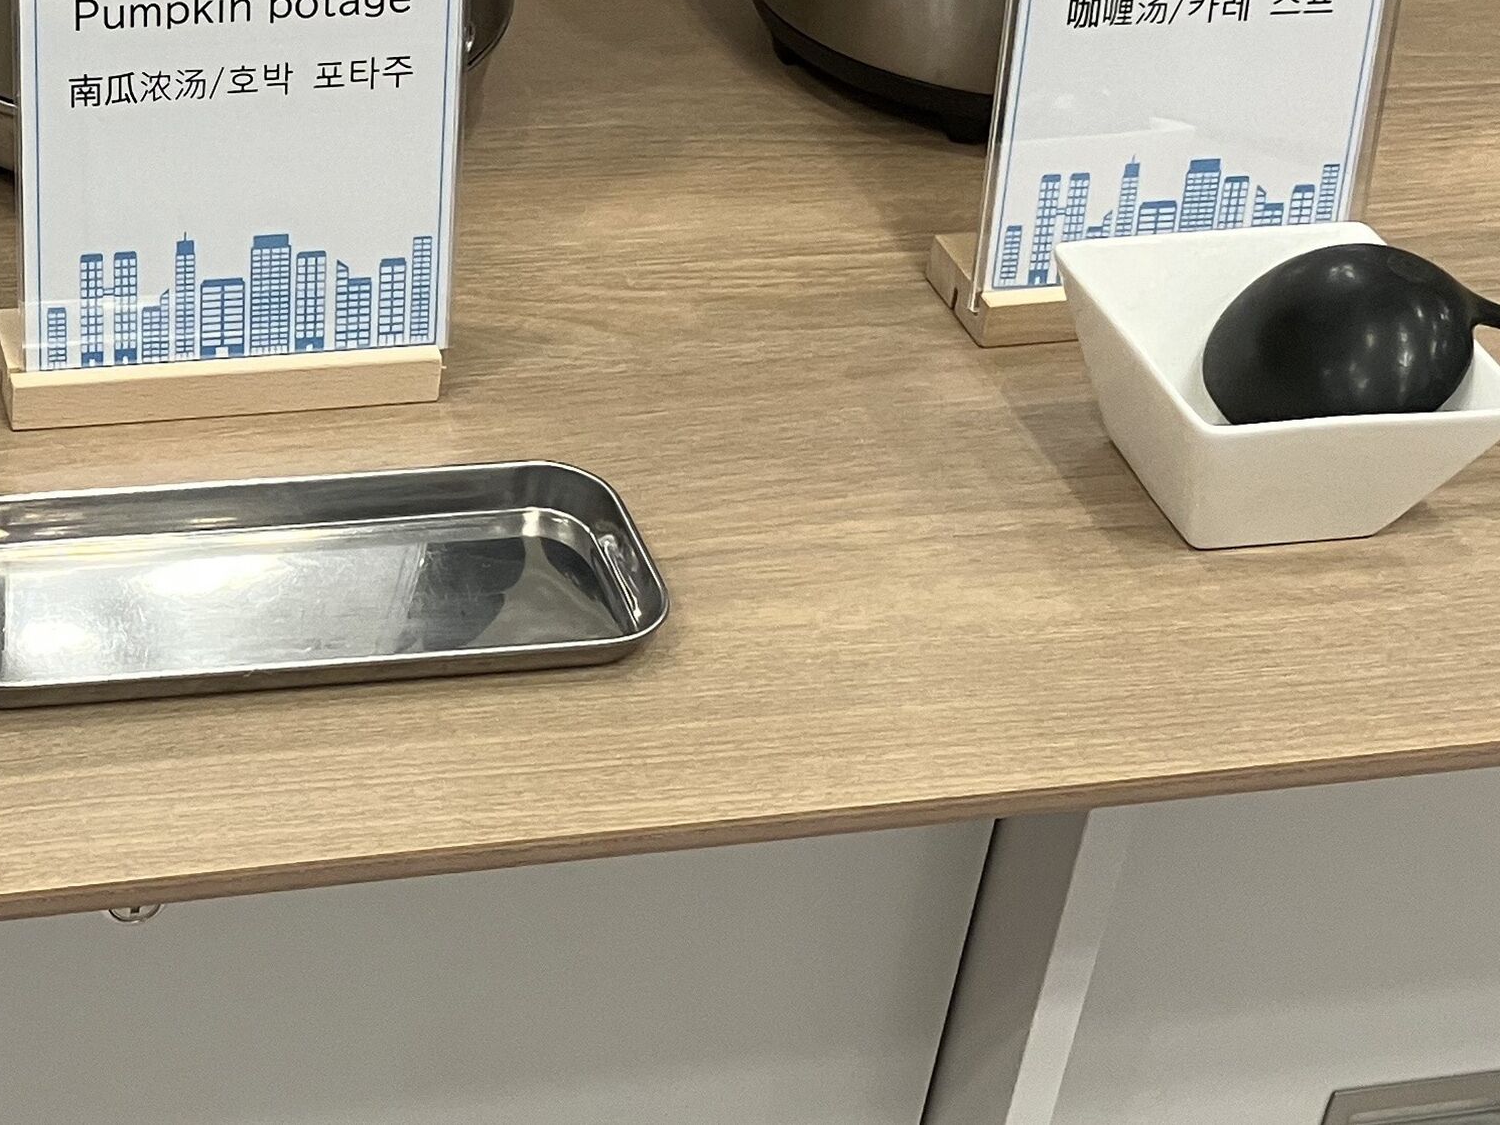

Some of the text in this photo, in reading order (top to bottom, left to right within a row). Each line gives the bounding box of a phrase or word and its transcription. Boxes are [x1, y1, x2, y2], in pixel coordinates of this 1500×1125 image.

[69, 56, 414, 108] 南瓜浓汤/호박 포타주
